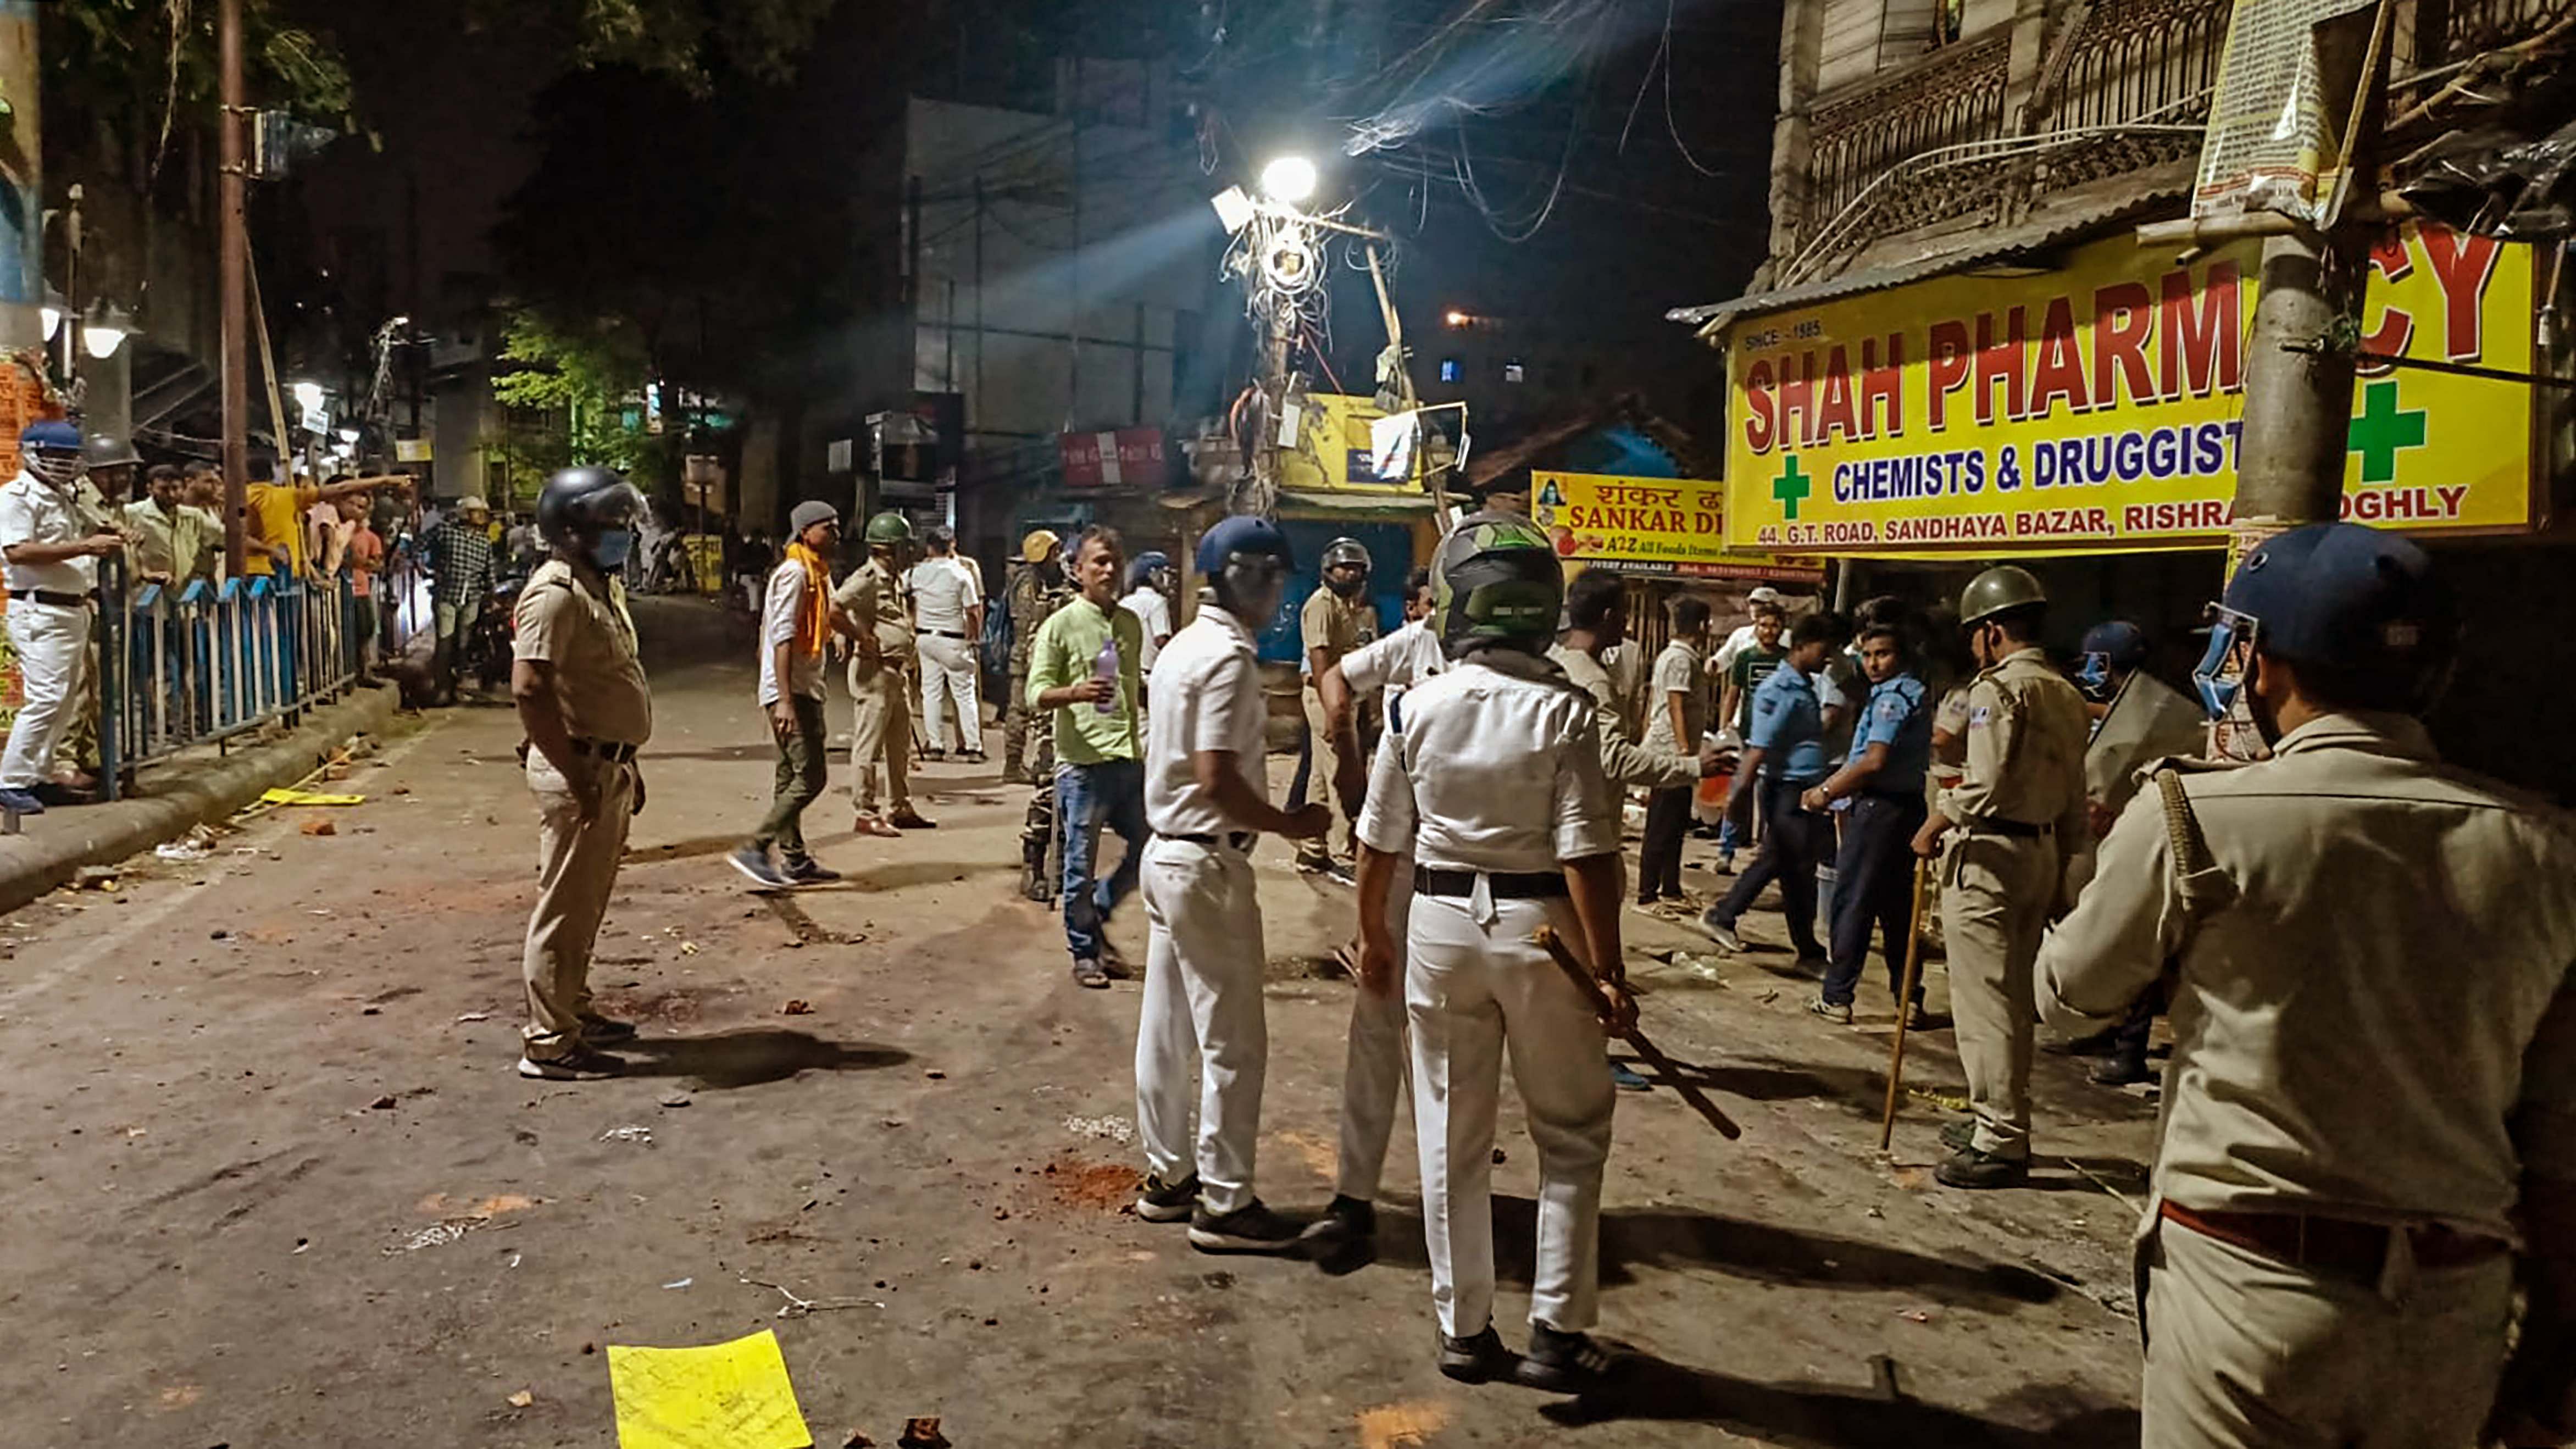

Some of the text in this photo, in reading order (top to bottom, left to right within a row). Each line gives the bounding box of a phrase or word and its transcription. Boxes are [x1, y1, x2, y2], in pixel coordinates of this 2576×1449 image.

[1745, 218, 2503, 456] SHAH PHARMCY
[1746, 330, 1779, 351] SINCE
[1834, 449, 1985, 503] CHEMISTS
[1997, 446, 2021, 491] &
[1594, 481, 1683, 508] शंकर
[1570, 506, 1686, 533] SANKAR
[1885, 514, 2007, 540] SANDHAYA
[2016, 509, 2114, 536] BAZAR,
[1606, 536, 1637, 553] A2Z
